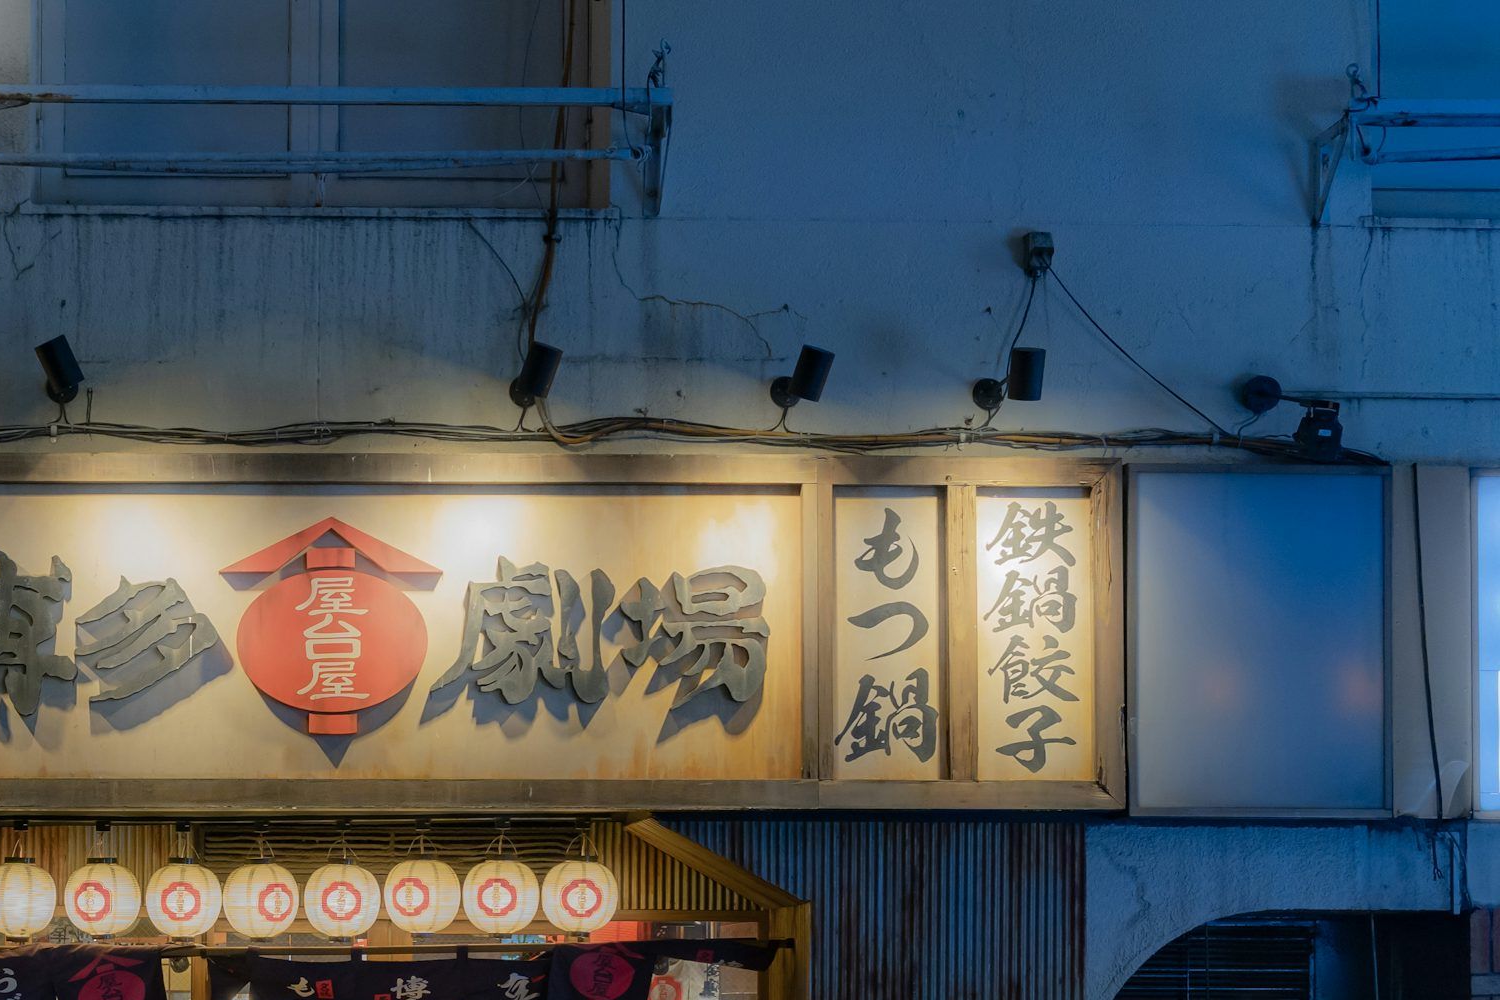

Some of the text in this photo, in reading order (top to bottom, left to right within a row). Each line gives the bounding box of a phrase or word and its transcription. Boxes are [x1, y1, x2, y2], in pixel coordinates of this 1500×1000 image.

[296, 576, 370, 701] 屋台屋
[430, 555, 771, 712] 劇場
[835, 507, 939, 763] もつ鍋
[983, 501, 1080, 773] 鉄鍋餃子
